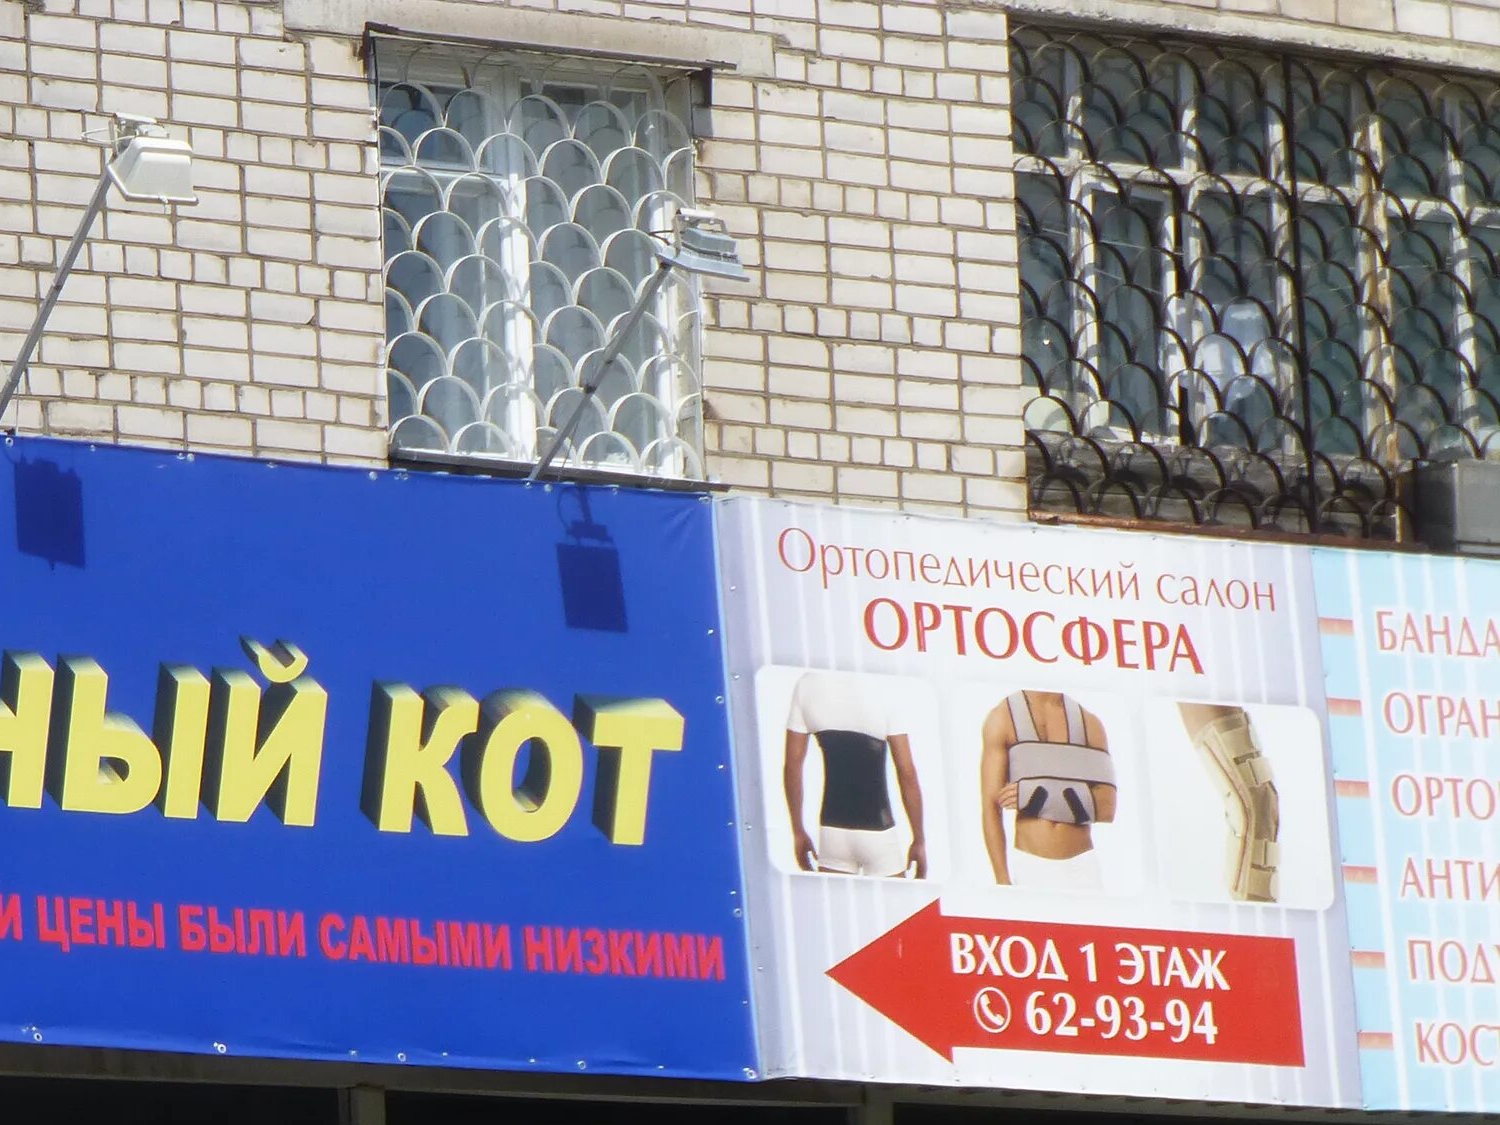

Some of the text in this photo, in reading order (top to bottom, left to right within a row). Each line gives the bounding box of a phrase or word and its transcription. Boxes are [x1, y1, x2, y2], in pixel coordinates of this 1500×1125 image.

[777, 527, 1277, 612] Ортопедический салон
[862, 597, 1205, 675] ОРТОСФЕРА
[360, 678, 686, 846] КОТ
[1391, 773, 1500, 822] ОРТО
[36, 894, 165, 952] ЦЕНЫ
[179, 902, 305, 960] БЫЛИ
[318, 912, 512, 971] САМЫМИ
[524, 924, 726, 983] НИЗКИМИ
[950, 931, 1231, 992] ВХОД 1 ЭТАЖ
[1407, 939, 1500, 985] ПОД
[1026, 990, 1219, 1044] 62-93-94
